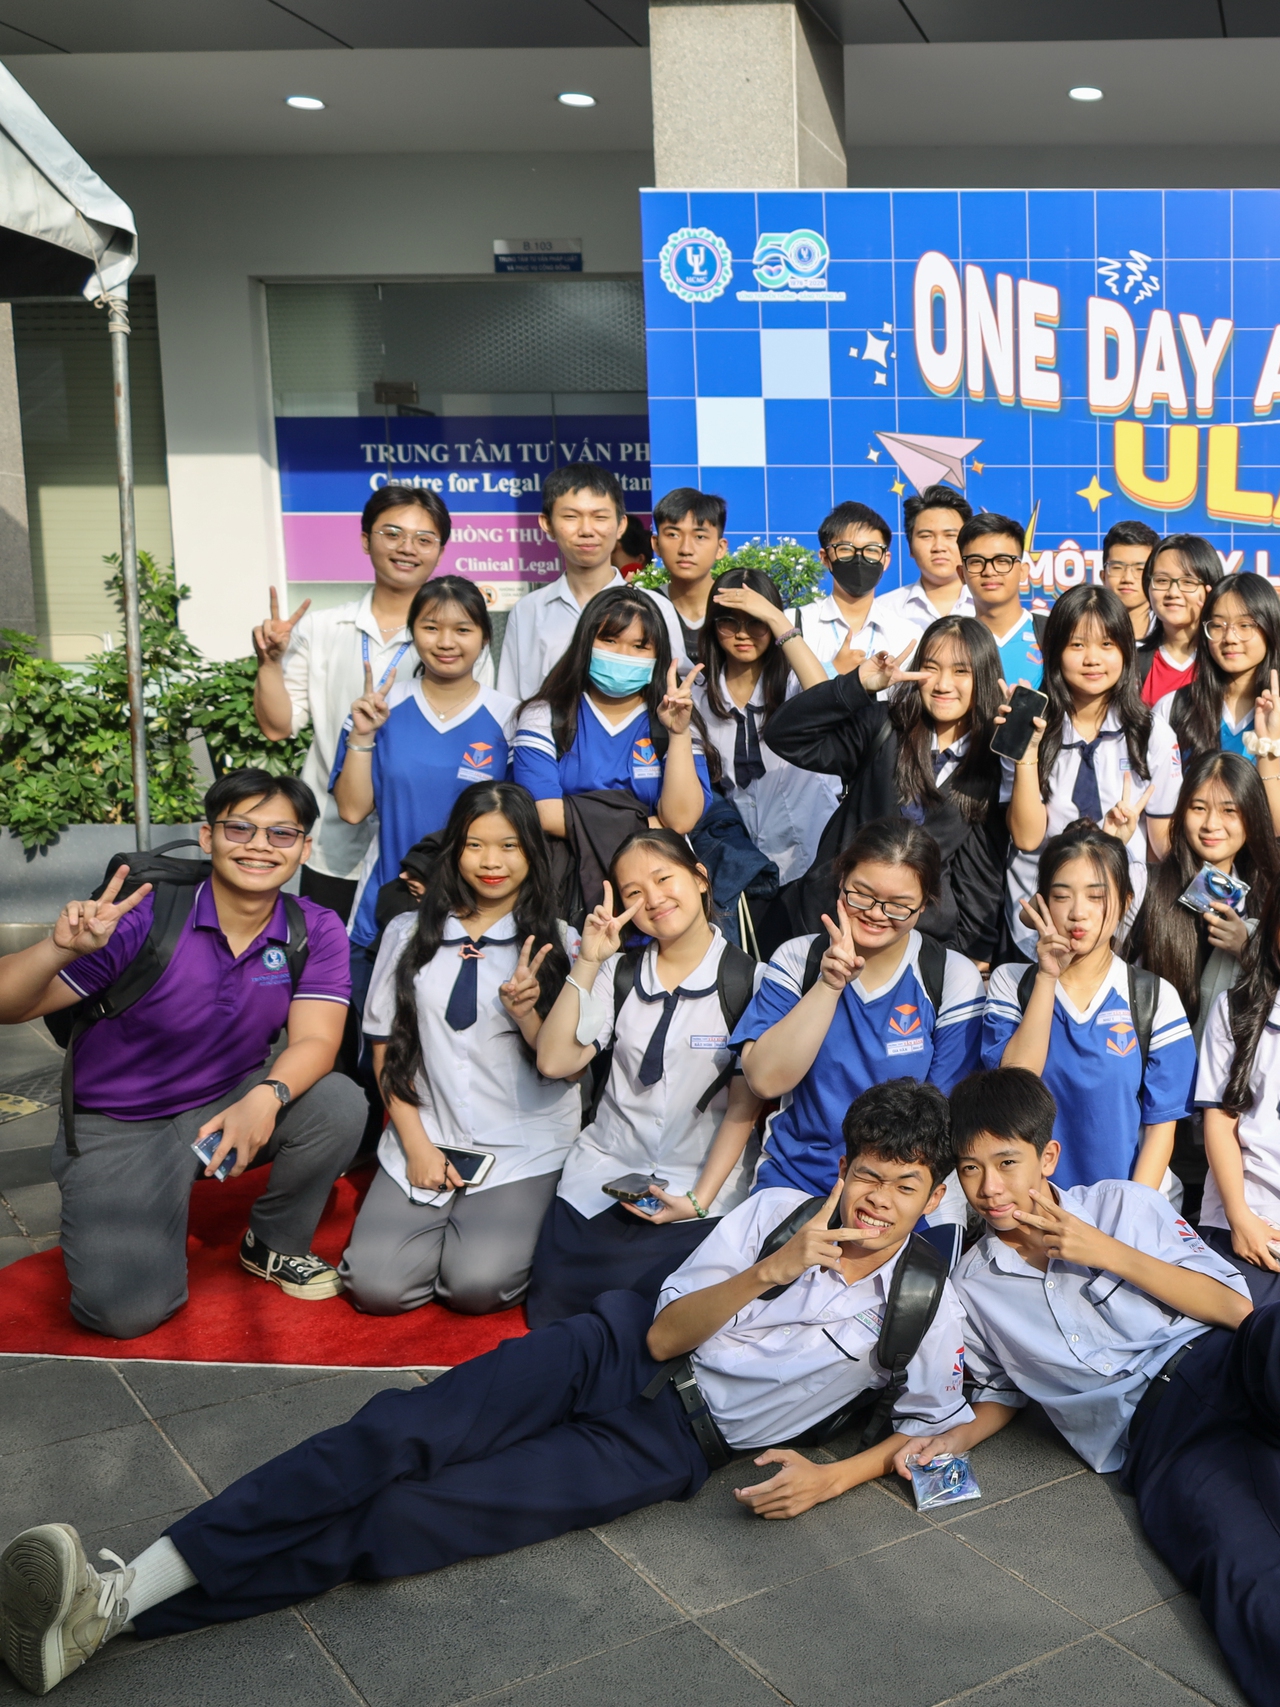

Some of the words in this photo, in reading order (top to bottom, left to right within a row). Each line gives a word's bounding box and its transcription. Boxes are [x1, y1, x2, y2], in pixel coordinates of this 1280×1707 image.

[913, 250, 1061, 410] ONE
[1087, 295, 1233, 417] DAY
[361, 443, 449, 463] TRUNG
[455, 438, 510, 463] TÂM
[517, 441, 555, 463] TƯ
[560, 437, 611, 462] VẤN
[619, 442, 650, 462] PH
[449, 472, 480, 492] for
[483, 473, 541, 497] Legal
[450, 522, 503, 543] HÒNG
[455, 557, 514, 573] Clinical
[518, 557, 560, 575] Legal
